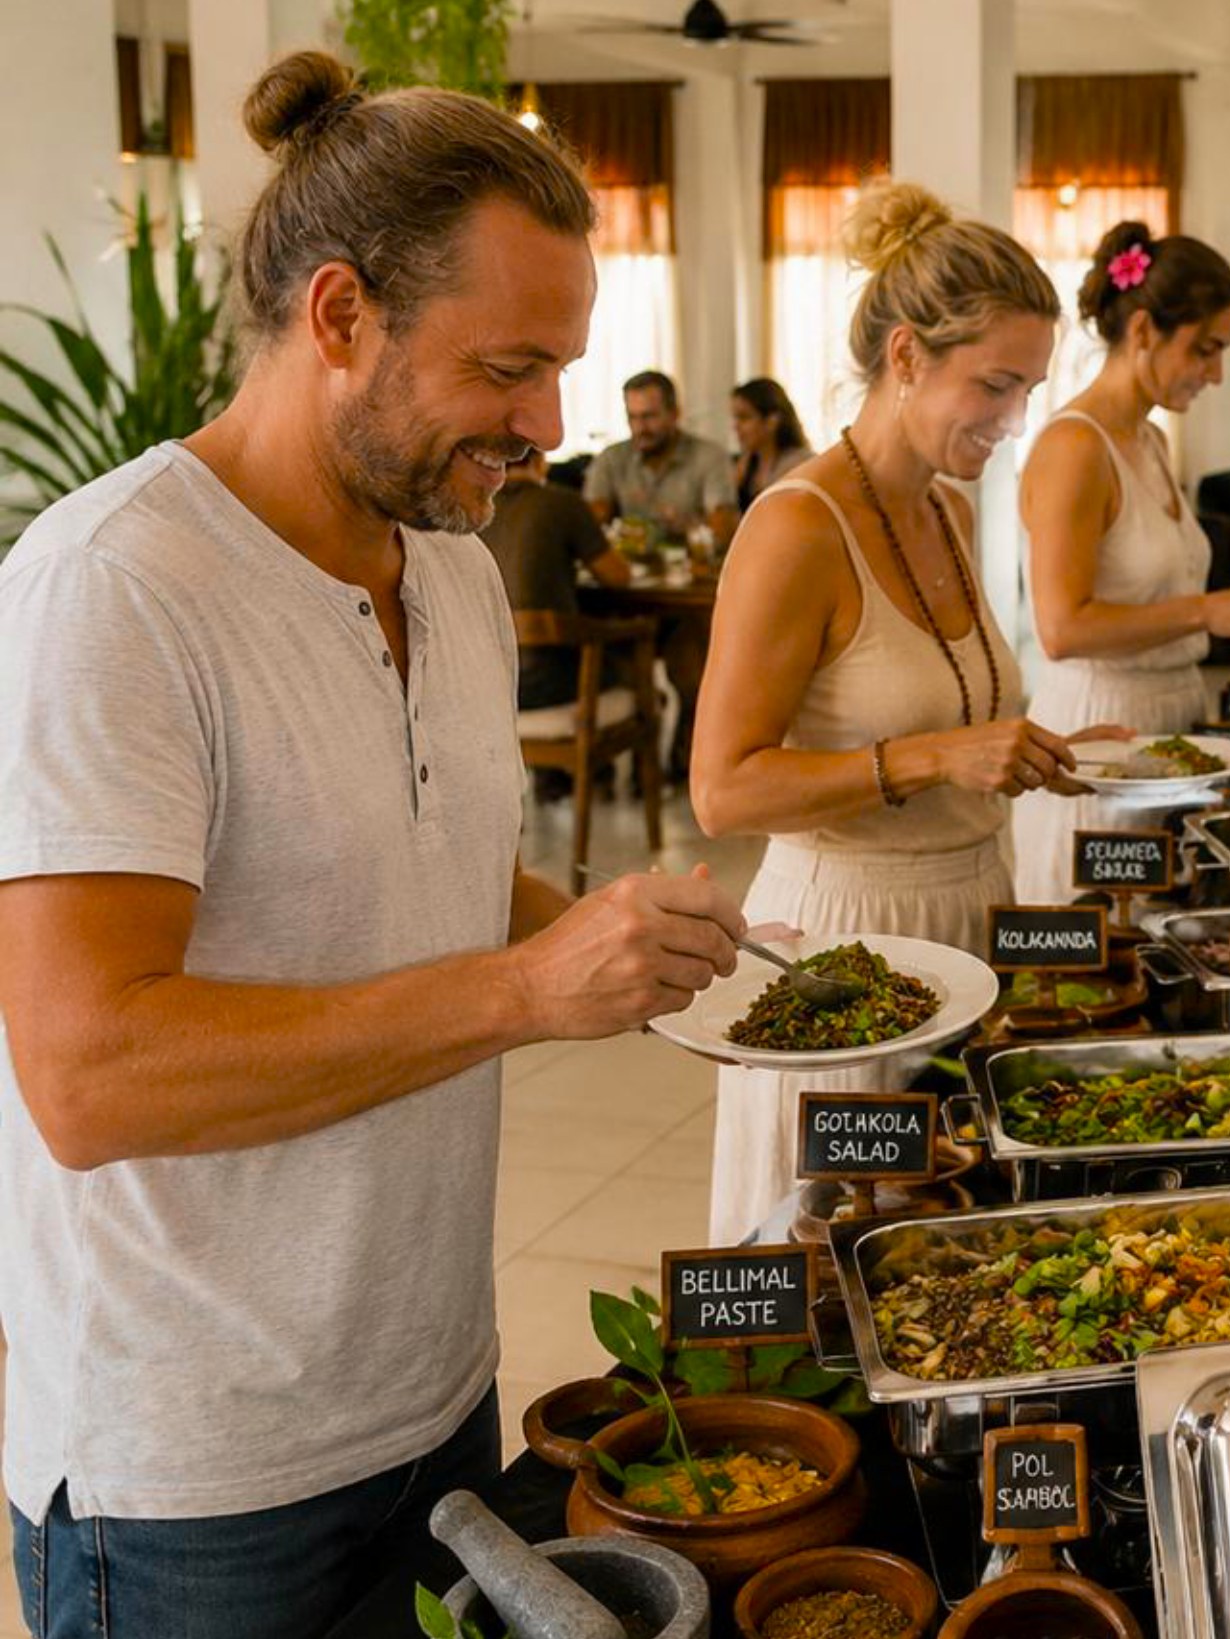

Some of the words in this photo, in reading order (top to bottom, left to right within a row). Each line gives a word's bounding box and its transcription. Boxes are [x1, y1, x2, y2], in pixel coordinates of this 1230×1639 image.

[827, 1140, 900, 1162] SALAD
[680, 1266, 796, 1295] BELLIMAL
[700, 1300, 778, 1328] PASTE
[1012, 1452, 1054, 1478] POL
